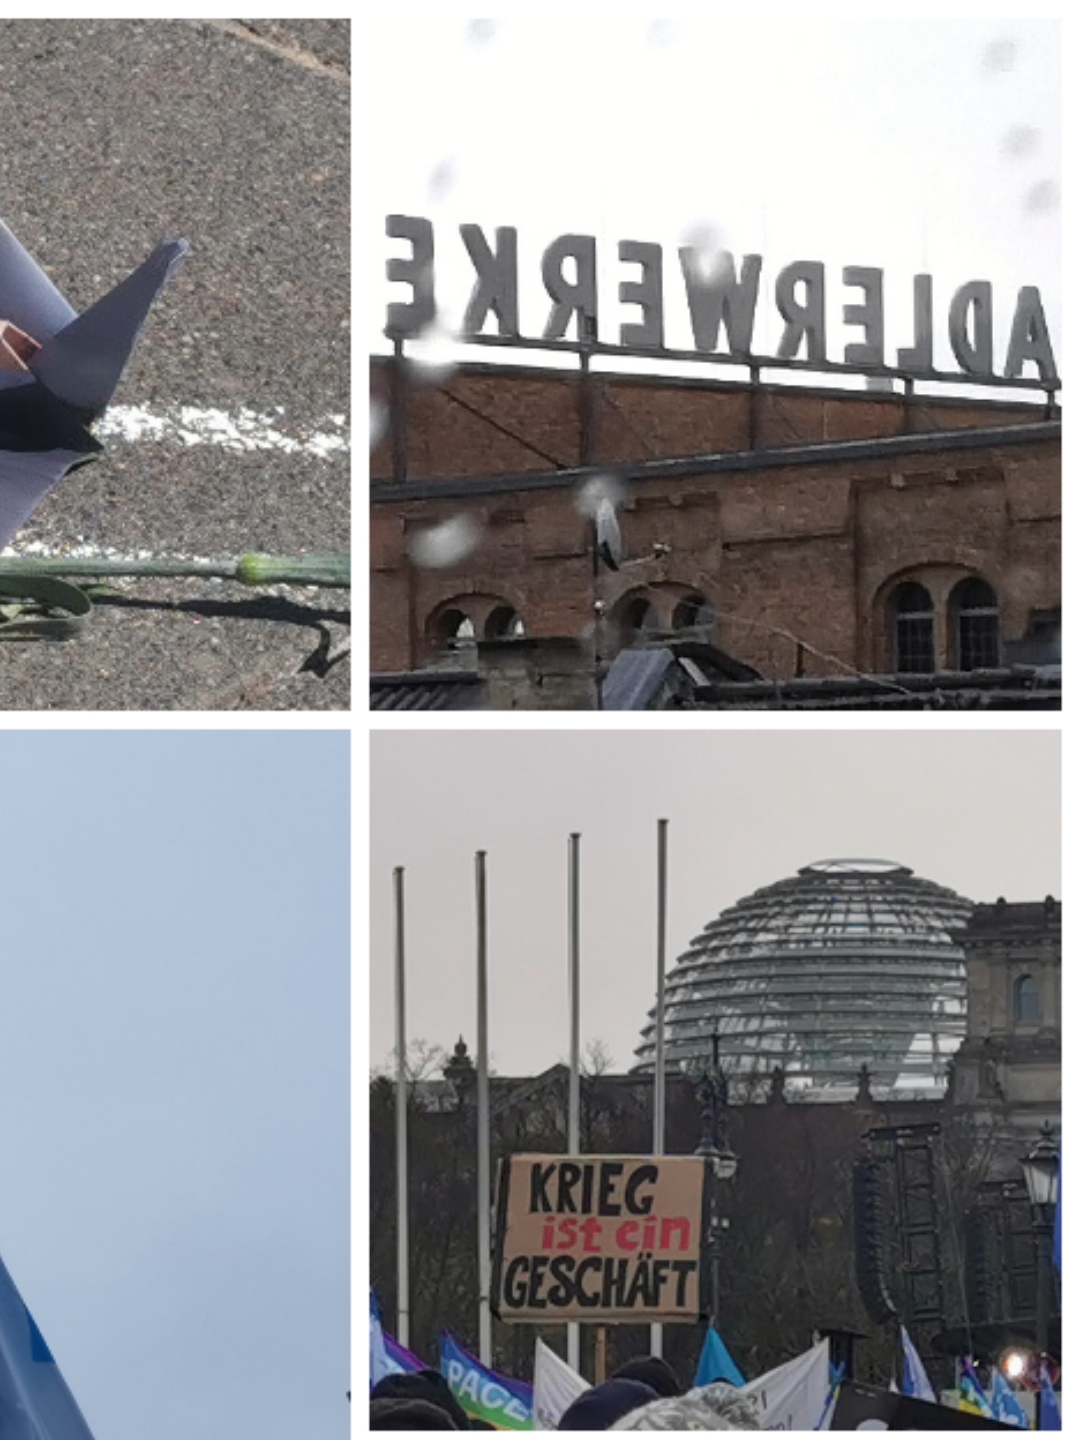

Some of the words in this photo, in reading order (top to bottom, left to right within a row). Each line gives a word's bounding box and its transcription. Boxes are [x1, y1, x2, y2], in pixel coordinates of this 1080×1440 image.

[528, 1163, 659, 1216] KRIEG
[542, 1215, 603, 1253] ist
[615, 1215, 691, 1252] ein
[503, 1252, 697, 1308] GESCHÄFT
[447, 1359, 529, 1422] PACE
